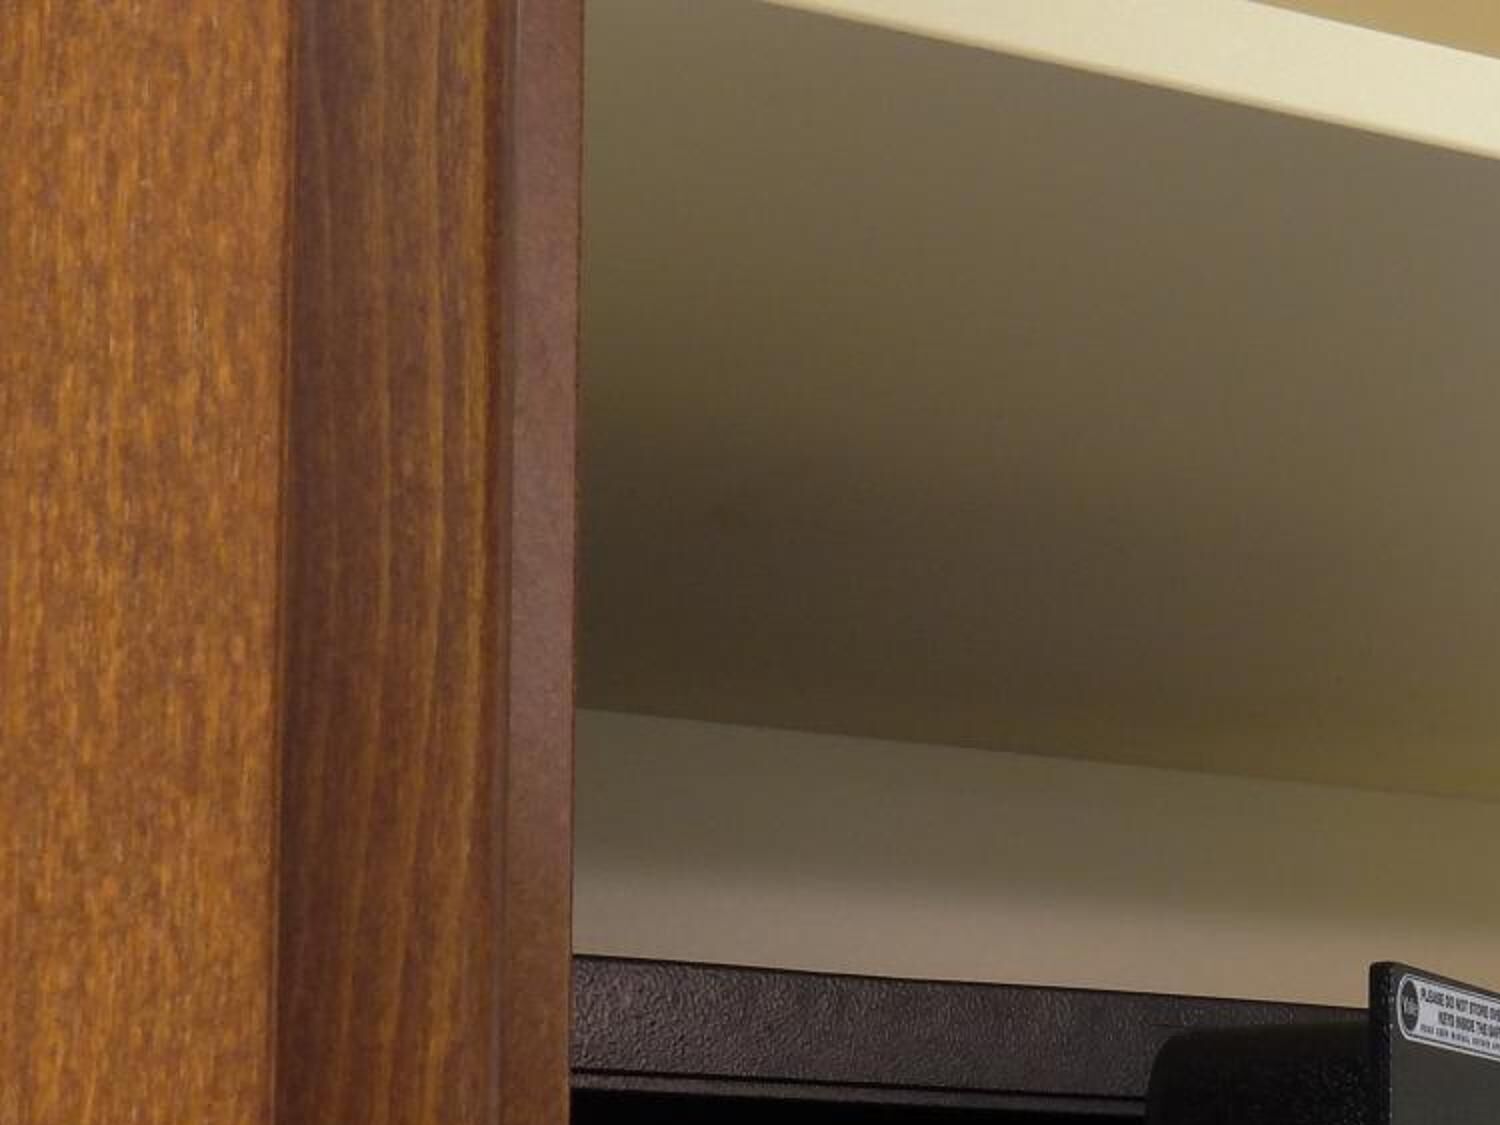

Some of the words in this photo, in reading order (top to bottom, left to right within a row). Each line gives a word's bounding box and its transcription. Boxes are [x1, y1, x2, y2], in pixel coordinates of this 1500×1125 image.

[1420, 987, 1444, 1006] PLEASE
[1446, 994, 1454, 1008] DO
[1456, 997, 1469, 1012] NOT
[1470, 1000, 1489, 1019] STORE
[1438, 1012, 1454, 1027] KEYS
[1456, 1015, 1475, 1033] INSIDE
[1476, 1020, 1488, 1035] THE
